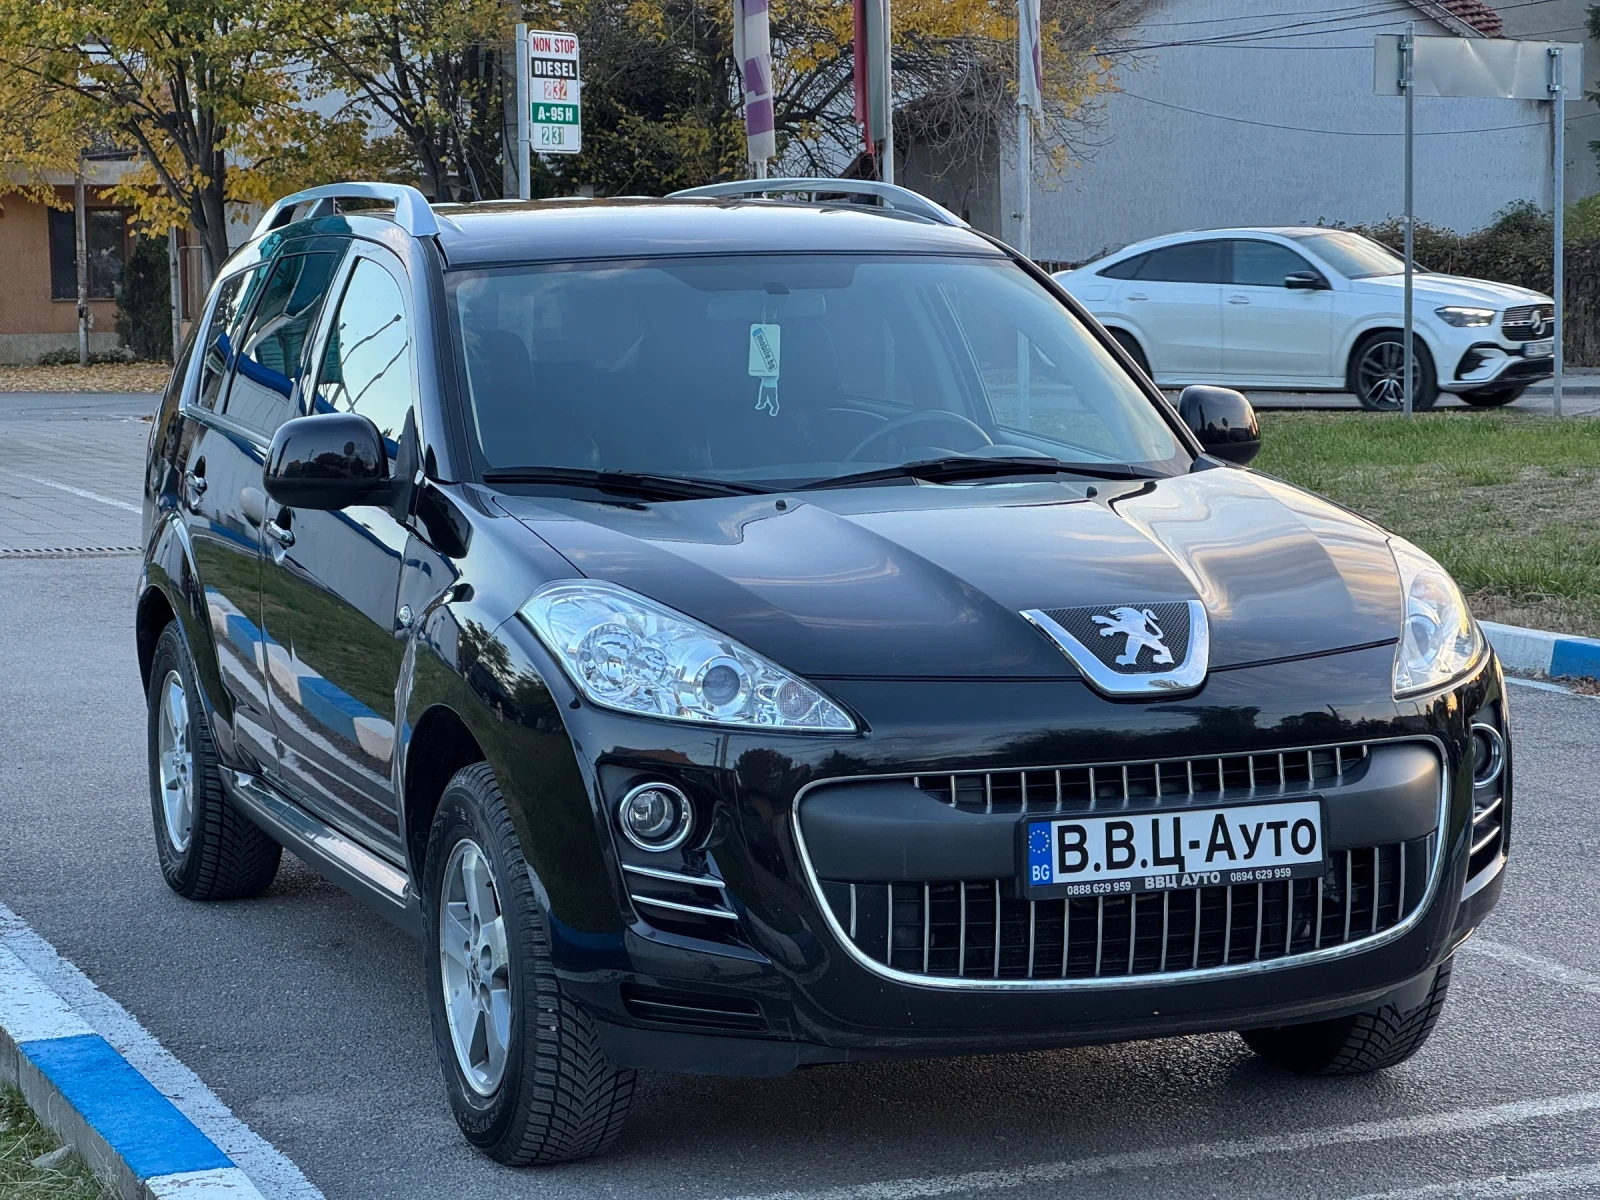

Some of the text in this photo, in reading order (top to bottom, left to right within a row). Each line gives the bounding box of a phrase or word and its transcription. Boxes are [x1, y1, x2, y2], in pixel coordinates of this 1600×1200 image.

[533, 37, 575, 54] NON STOP
[534, 60, 575, 77] DIESEL
[756, 334, 776, 370] mobile.bg
[1032, 865, 1050, 882] BG
[1144, 871, 1221, 889] ВВЦ АУТО
[1230, 868, 1292, 882] 0894 629 959
[1067, 881, 1131, 895] 0888 629 959
